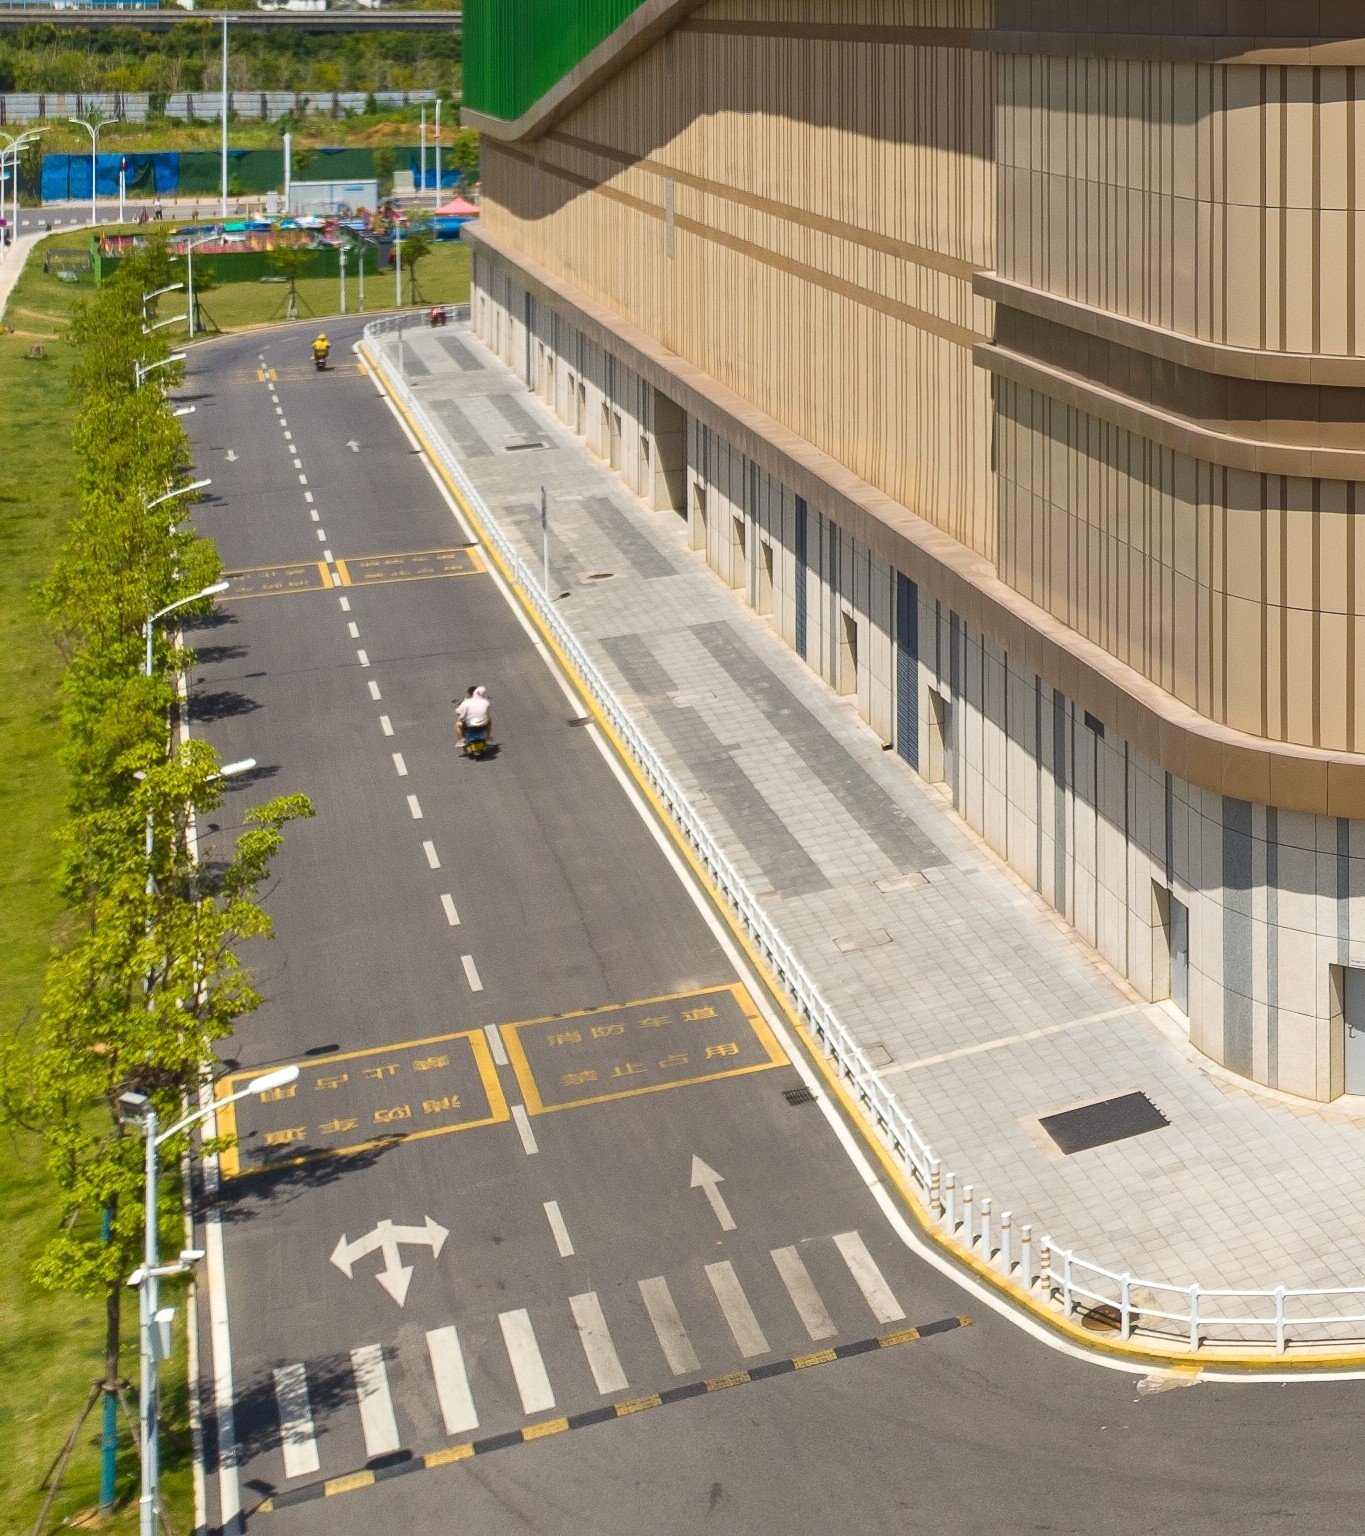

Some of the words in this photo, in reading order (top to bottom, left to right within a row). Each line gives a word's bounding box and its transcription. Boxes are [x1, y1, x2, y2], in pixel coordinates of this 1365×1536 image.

[547, 1005, 720, 1047] 消防车道
[561, 1041, 740, 1087] 禁止占用
[263, 1093, 461, 1146] 消防车道
